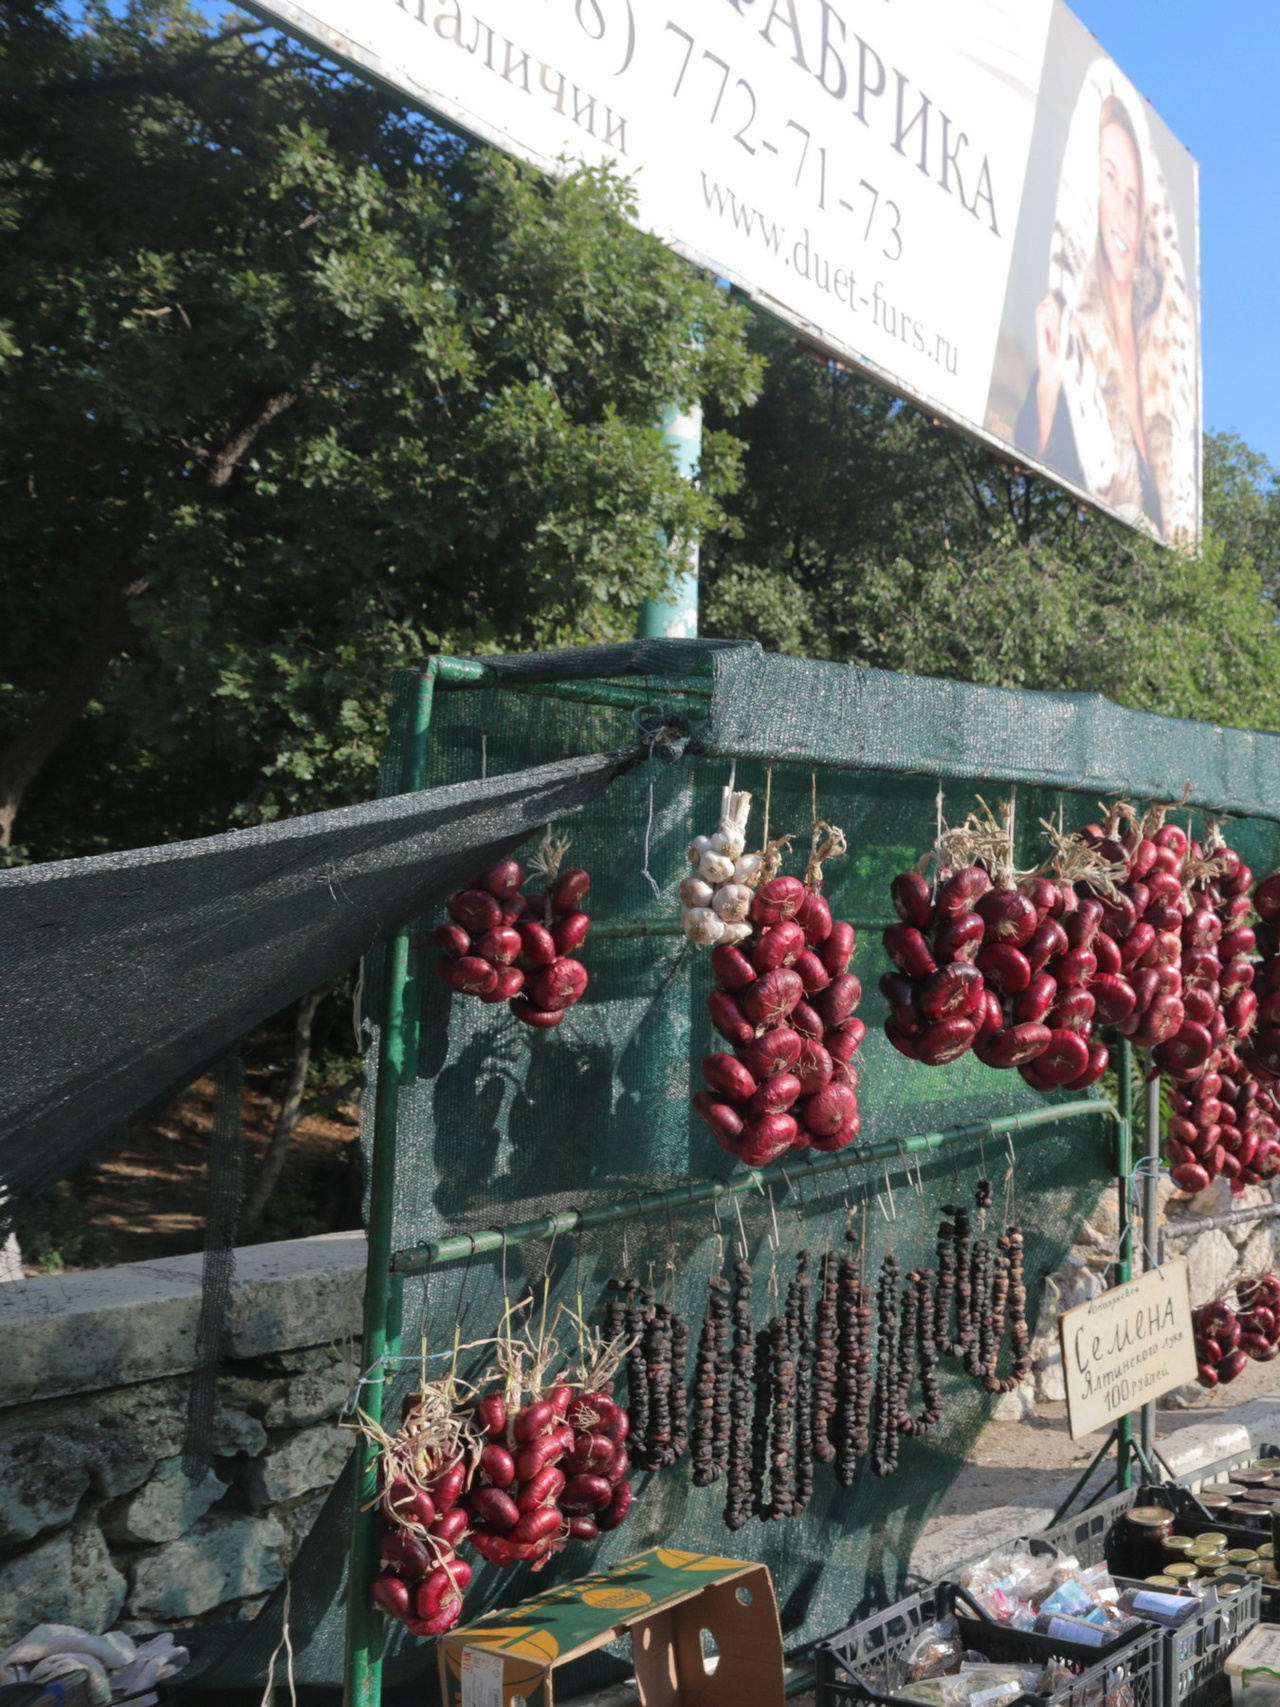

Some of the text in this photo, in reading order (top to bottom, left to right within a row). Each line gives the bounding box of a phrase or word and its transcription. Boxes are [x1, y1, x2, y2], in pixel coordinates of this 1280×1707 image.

[395, 0, 627, 156] аличии
[664, 20, 902, 261] 772-71-73
[727, 0, 1001, 238] АБРИКА
[700, 170, 958, 376] www.duet-furs.ru
[1104, 1378, 1130, 1412] 100
